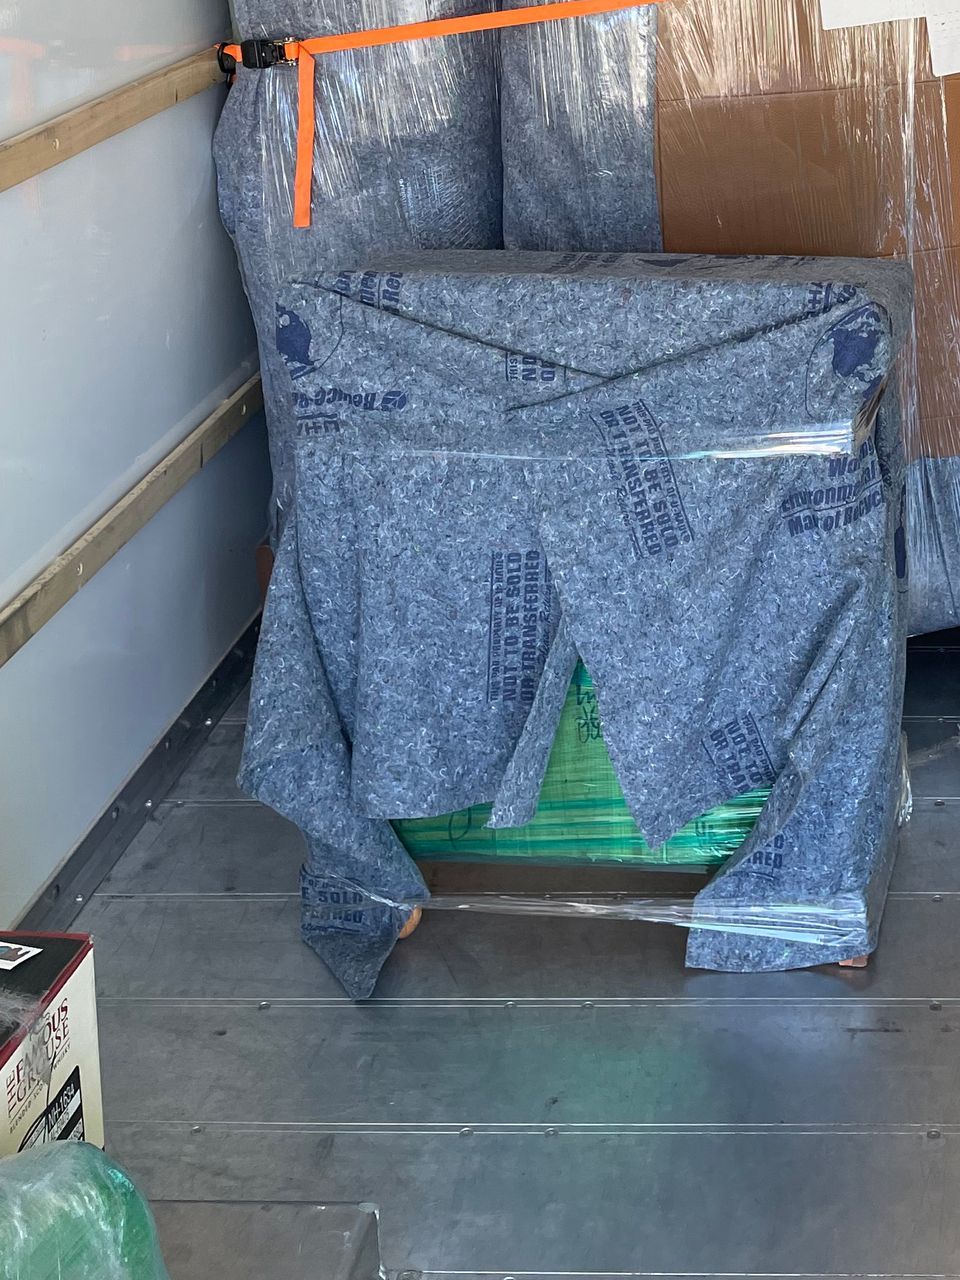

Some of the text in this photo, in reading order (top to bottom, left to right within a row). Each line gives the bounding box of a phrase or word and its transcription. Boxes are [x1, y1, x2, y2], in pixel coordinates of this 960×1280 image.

[644, 469, 662, 493] BE
[653, 499, 679, 548] SOLD
[503, 552, 522, 702] NOT TO BE SOLD
[522, 550, 540, 670] TRANSFERRED
